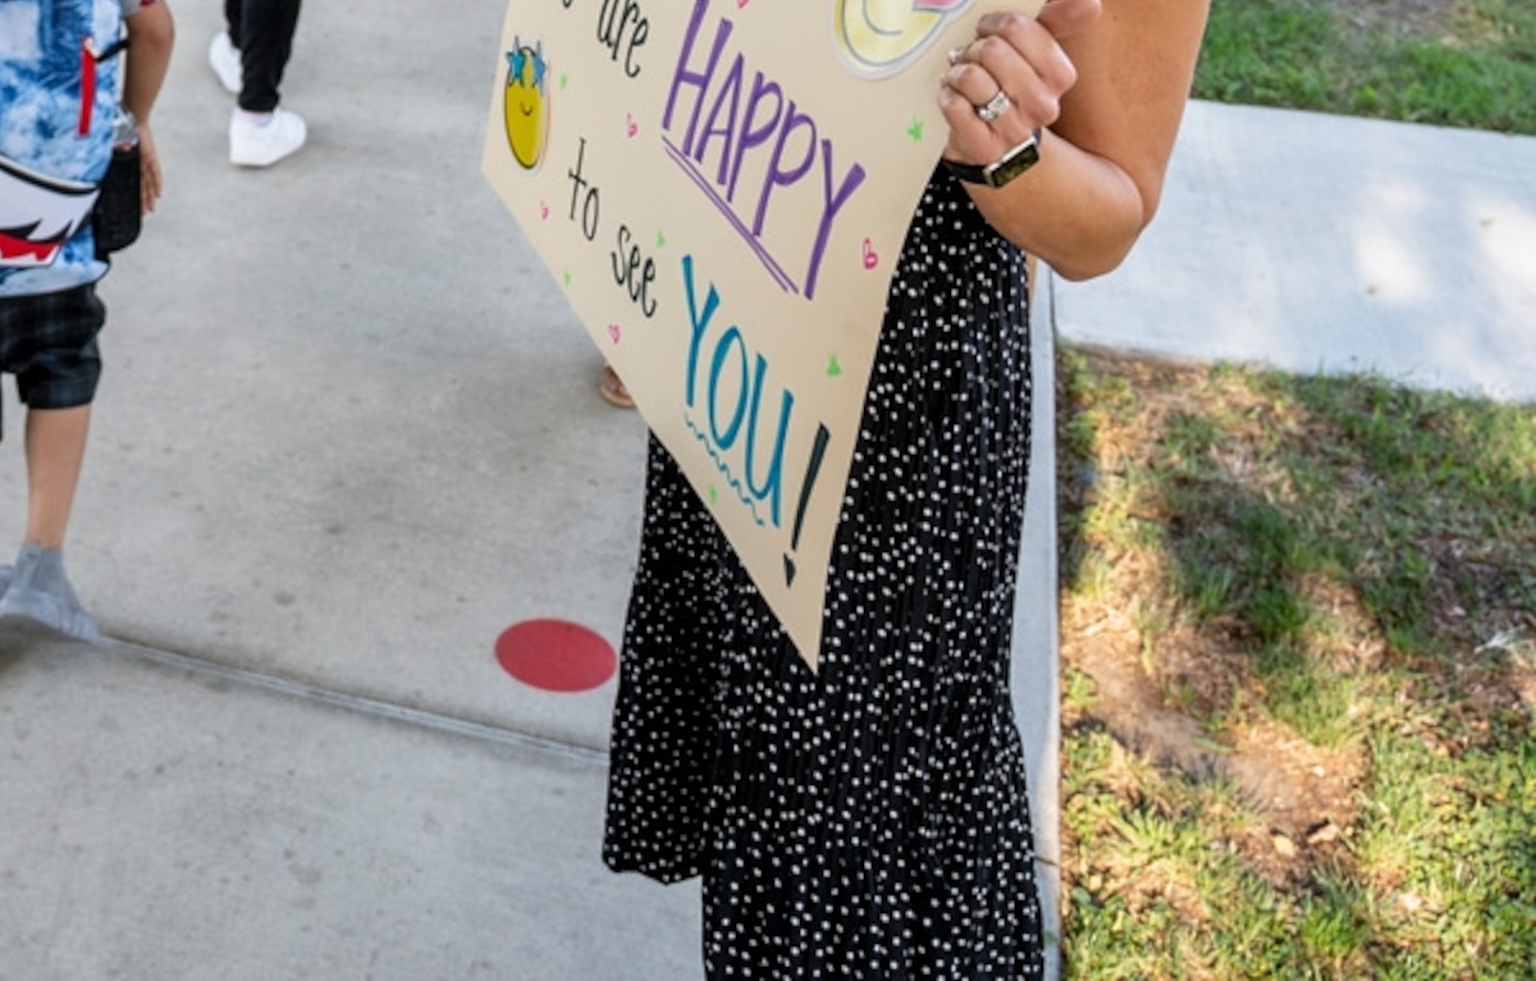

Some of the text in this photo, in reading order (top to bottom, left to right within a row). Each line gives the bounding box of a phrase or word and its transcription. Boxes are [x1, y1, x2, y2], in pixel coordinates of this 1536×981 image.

[567, 137, 658, 318] to see
[681, 254, 831, 588] YOU!
